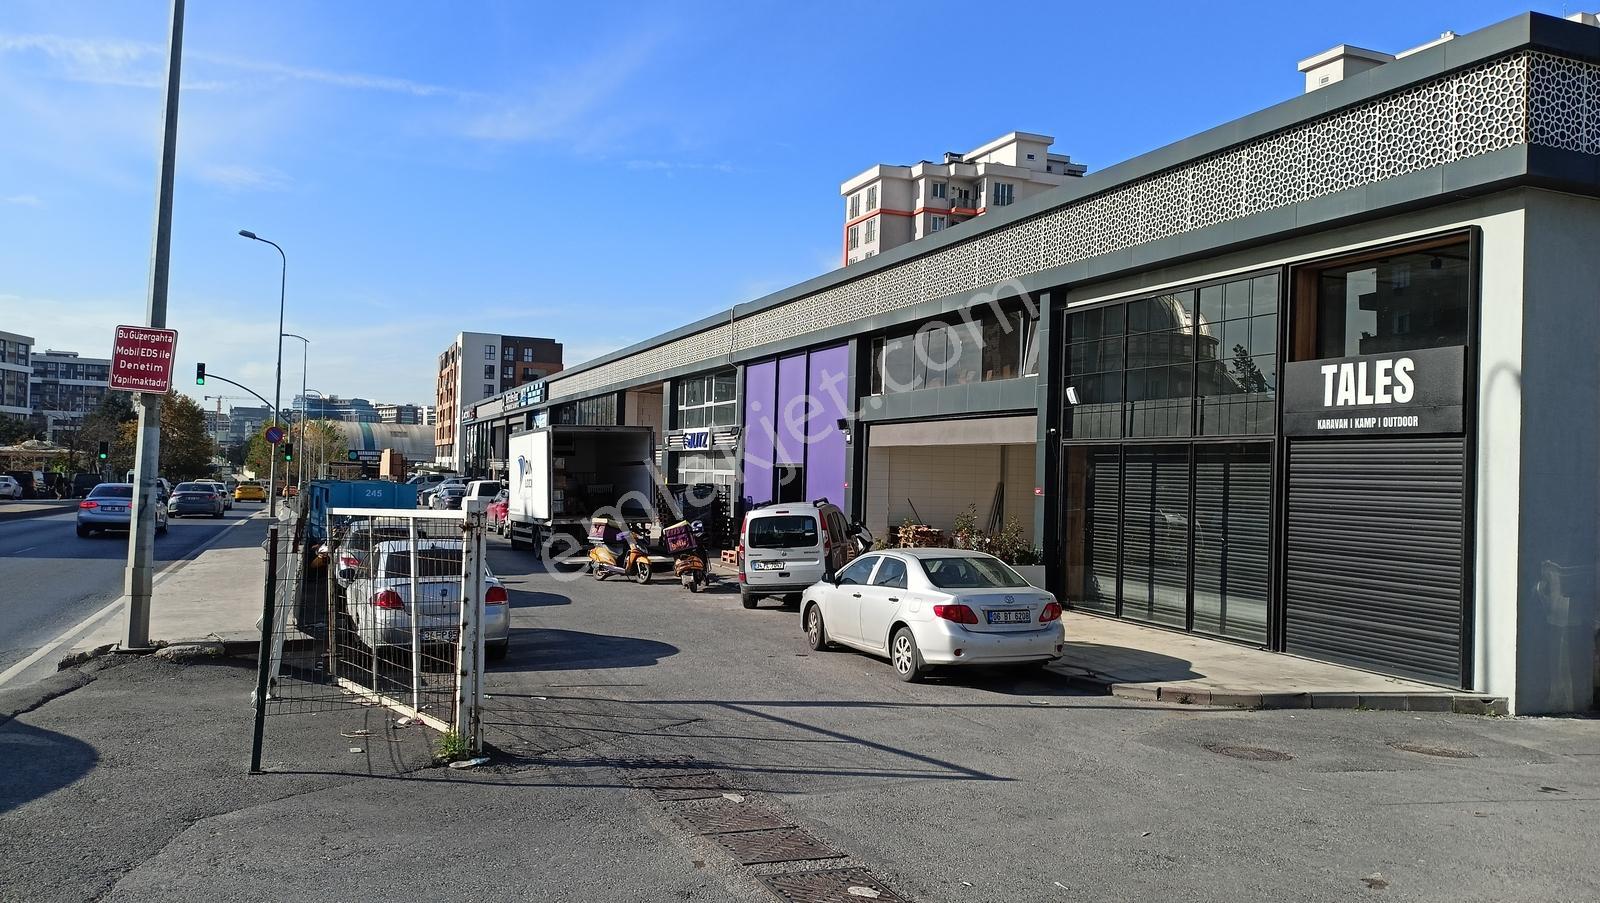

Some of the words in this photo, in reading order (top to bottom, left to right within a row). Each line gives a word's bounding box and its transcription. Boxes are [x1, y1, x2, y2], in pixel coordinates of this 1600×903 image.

[118, 330, 128, 339] Bu
[129, 331, 172, 343] Güzergahta
[116, 346, 139, 356] Mobil
[140, 348, 158, 358] EDS
[159, 350, 170, 359] ile
[120, 360, 163, 372] Denetim
[113, 374, 167, 387] Yapılmaktadır
[1321, 357, 1415, 407] TALES
[1317, 418, 1348, 430] KARAVAN
[1355, 417, 1376, 429] KAMP
[1383, 416, 1419, 428] OUTDOOR
[365, 489, 383, 497] 245
